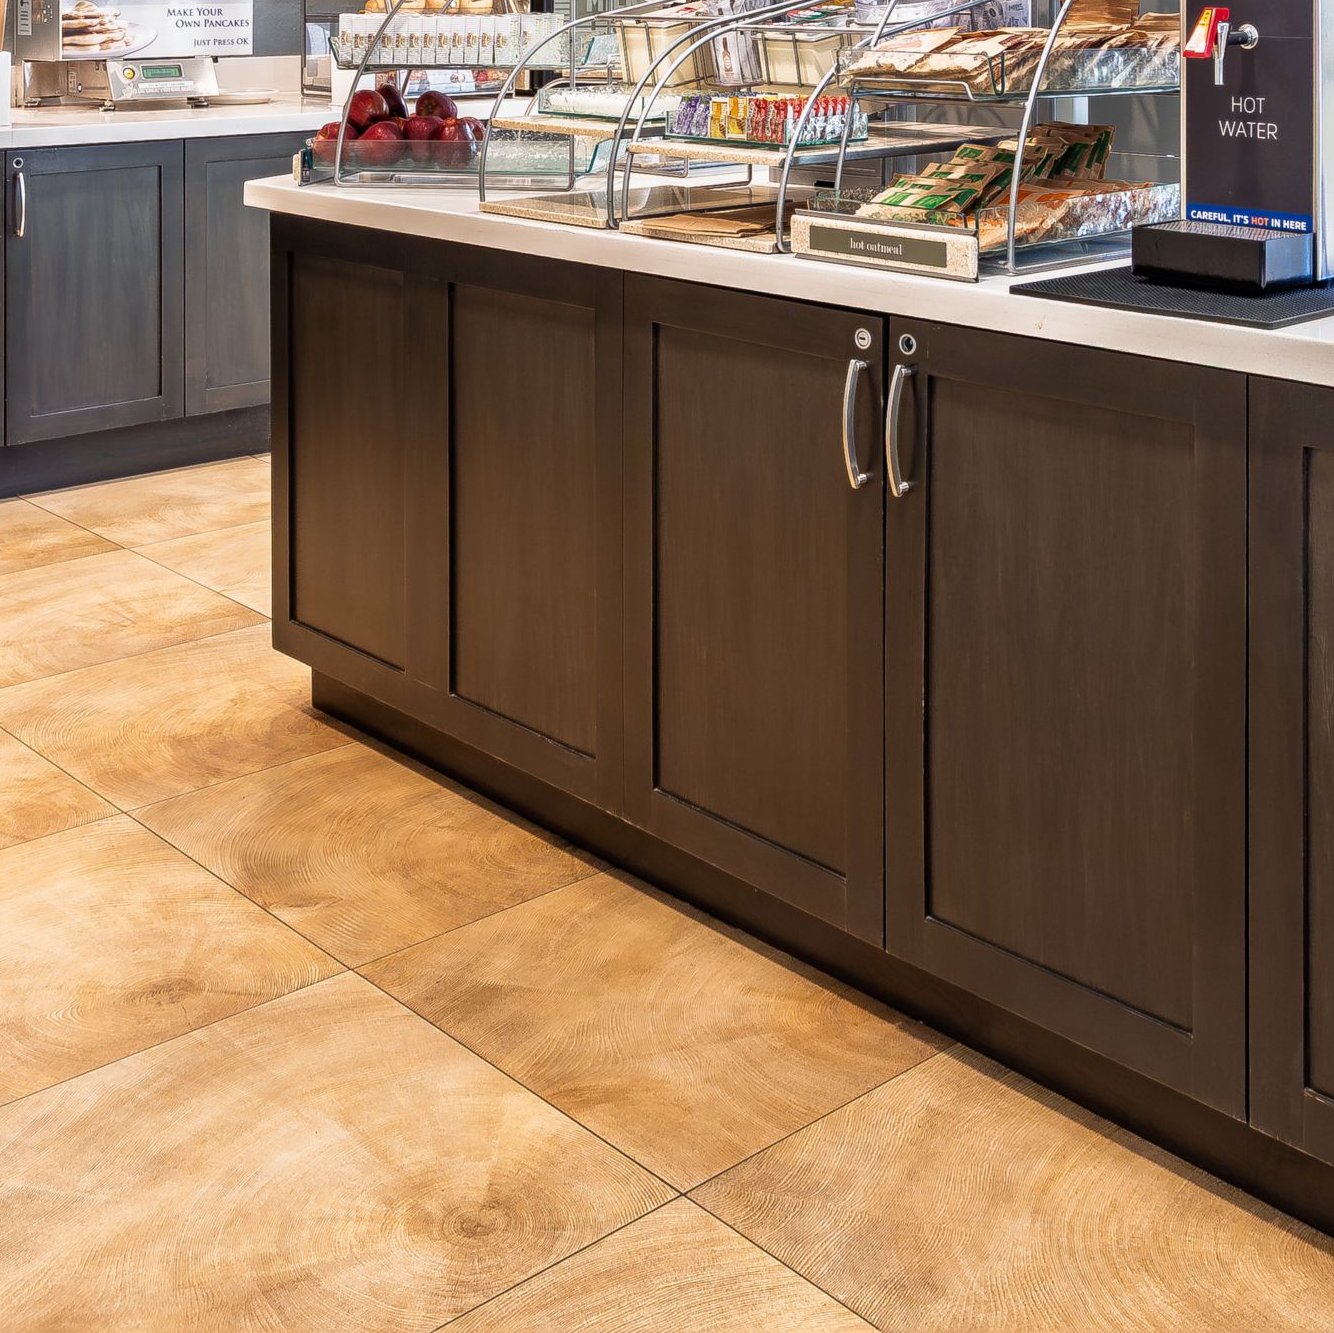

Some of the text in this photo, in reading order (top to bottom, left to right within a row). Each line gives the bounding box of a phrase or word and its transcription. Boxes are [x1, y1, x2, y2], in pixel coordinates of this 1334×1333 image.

[236, 37, 249, 46] OK
[1231, 96, 1265, 114] HOT
[1219, 120, 1278, 140] WATER
[1190, 209, 1307, 231] CAREFUL, IT'S HOT IN HERE
[850, 237, 902, 255] hot oatmeal
